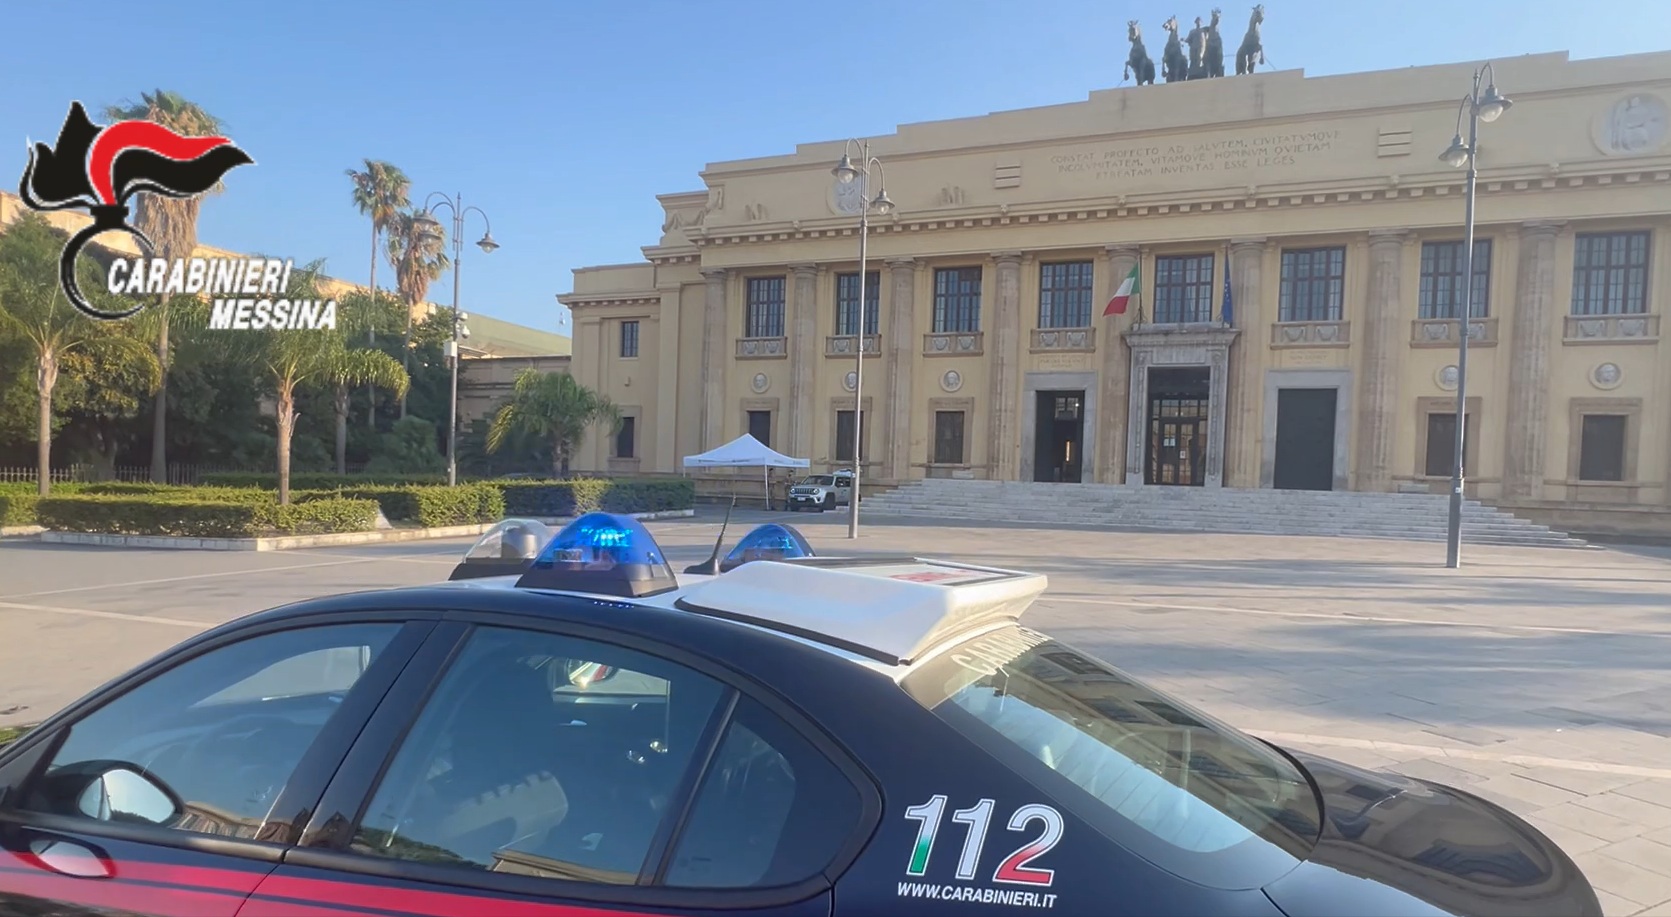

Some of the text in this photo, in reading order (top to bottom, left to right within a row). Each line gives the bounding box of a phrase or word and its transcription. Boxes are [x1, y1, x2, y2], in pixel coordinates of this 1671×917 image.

[1050, 152, 1094, 164] CONSTAT
[1104, 146, 1159, 159] PROFECTO
[1168, 145, 1184, 154] AD
[1274, 142, 1331, 156] QVIETAM
[1161, 163, 1214, 174] INVENTAS
[1225, 160, 1248, 170] ESSE
[1257, 156, 1295, 167] LEGES
[905, 794, 1064, 887] 112
[897, 882, 1058, 908] WWW.CARABINIERI.IT
